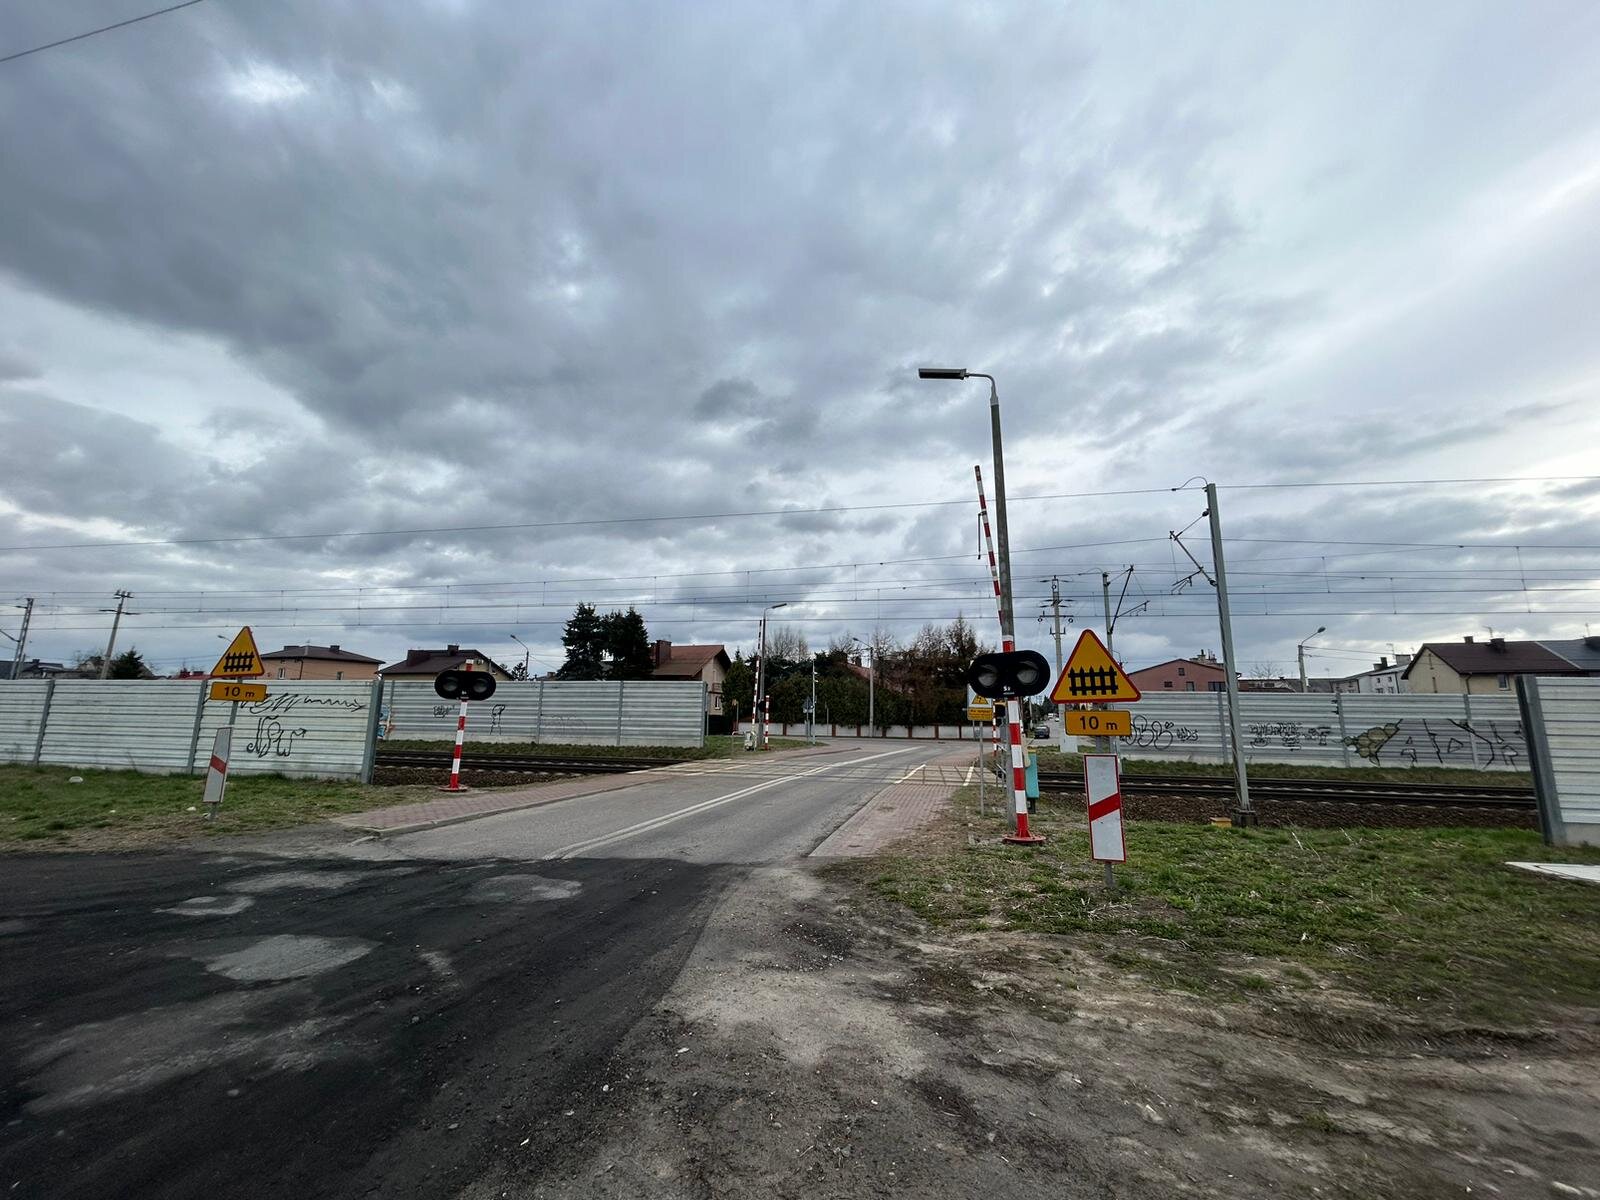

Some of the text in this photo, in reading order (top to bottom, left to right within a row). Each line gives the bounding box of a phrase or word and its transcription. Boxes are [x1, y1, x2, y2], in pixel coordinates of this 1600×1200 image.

[224, 686, 240, 697] 10
[1080, 716, 1118, 730] 10 m
